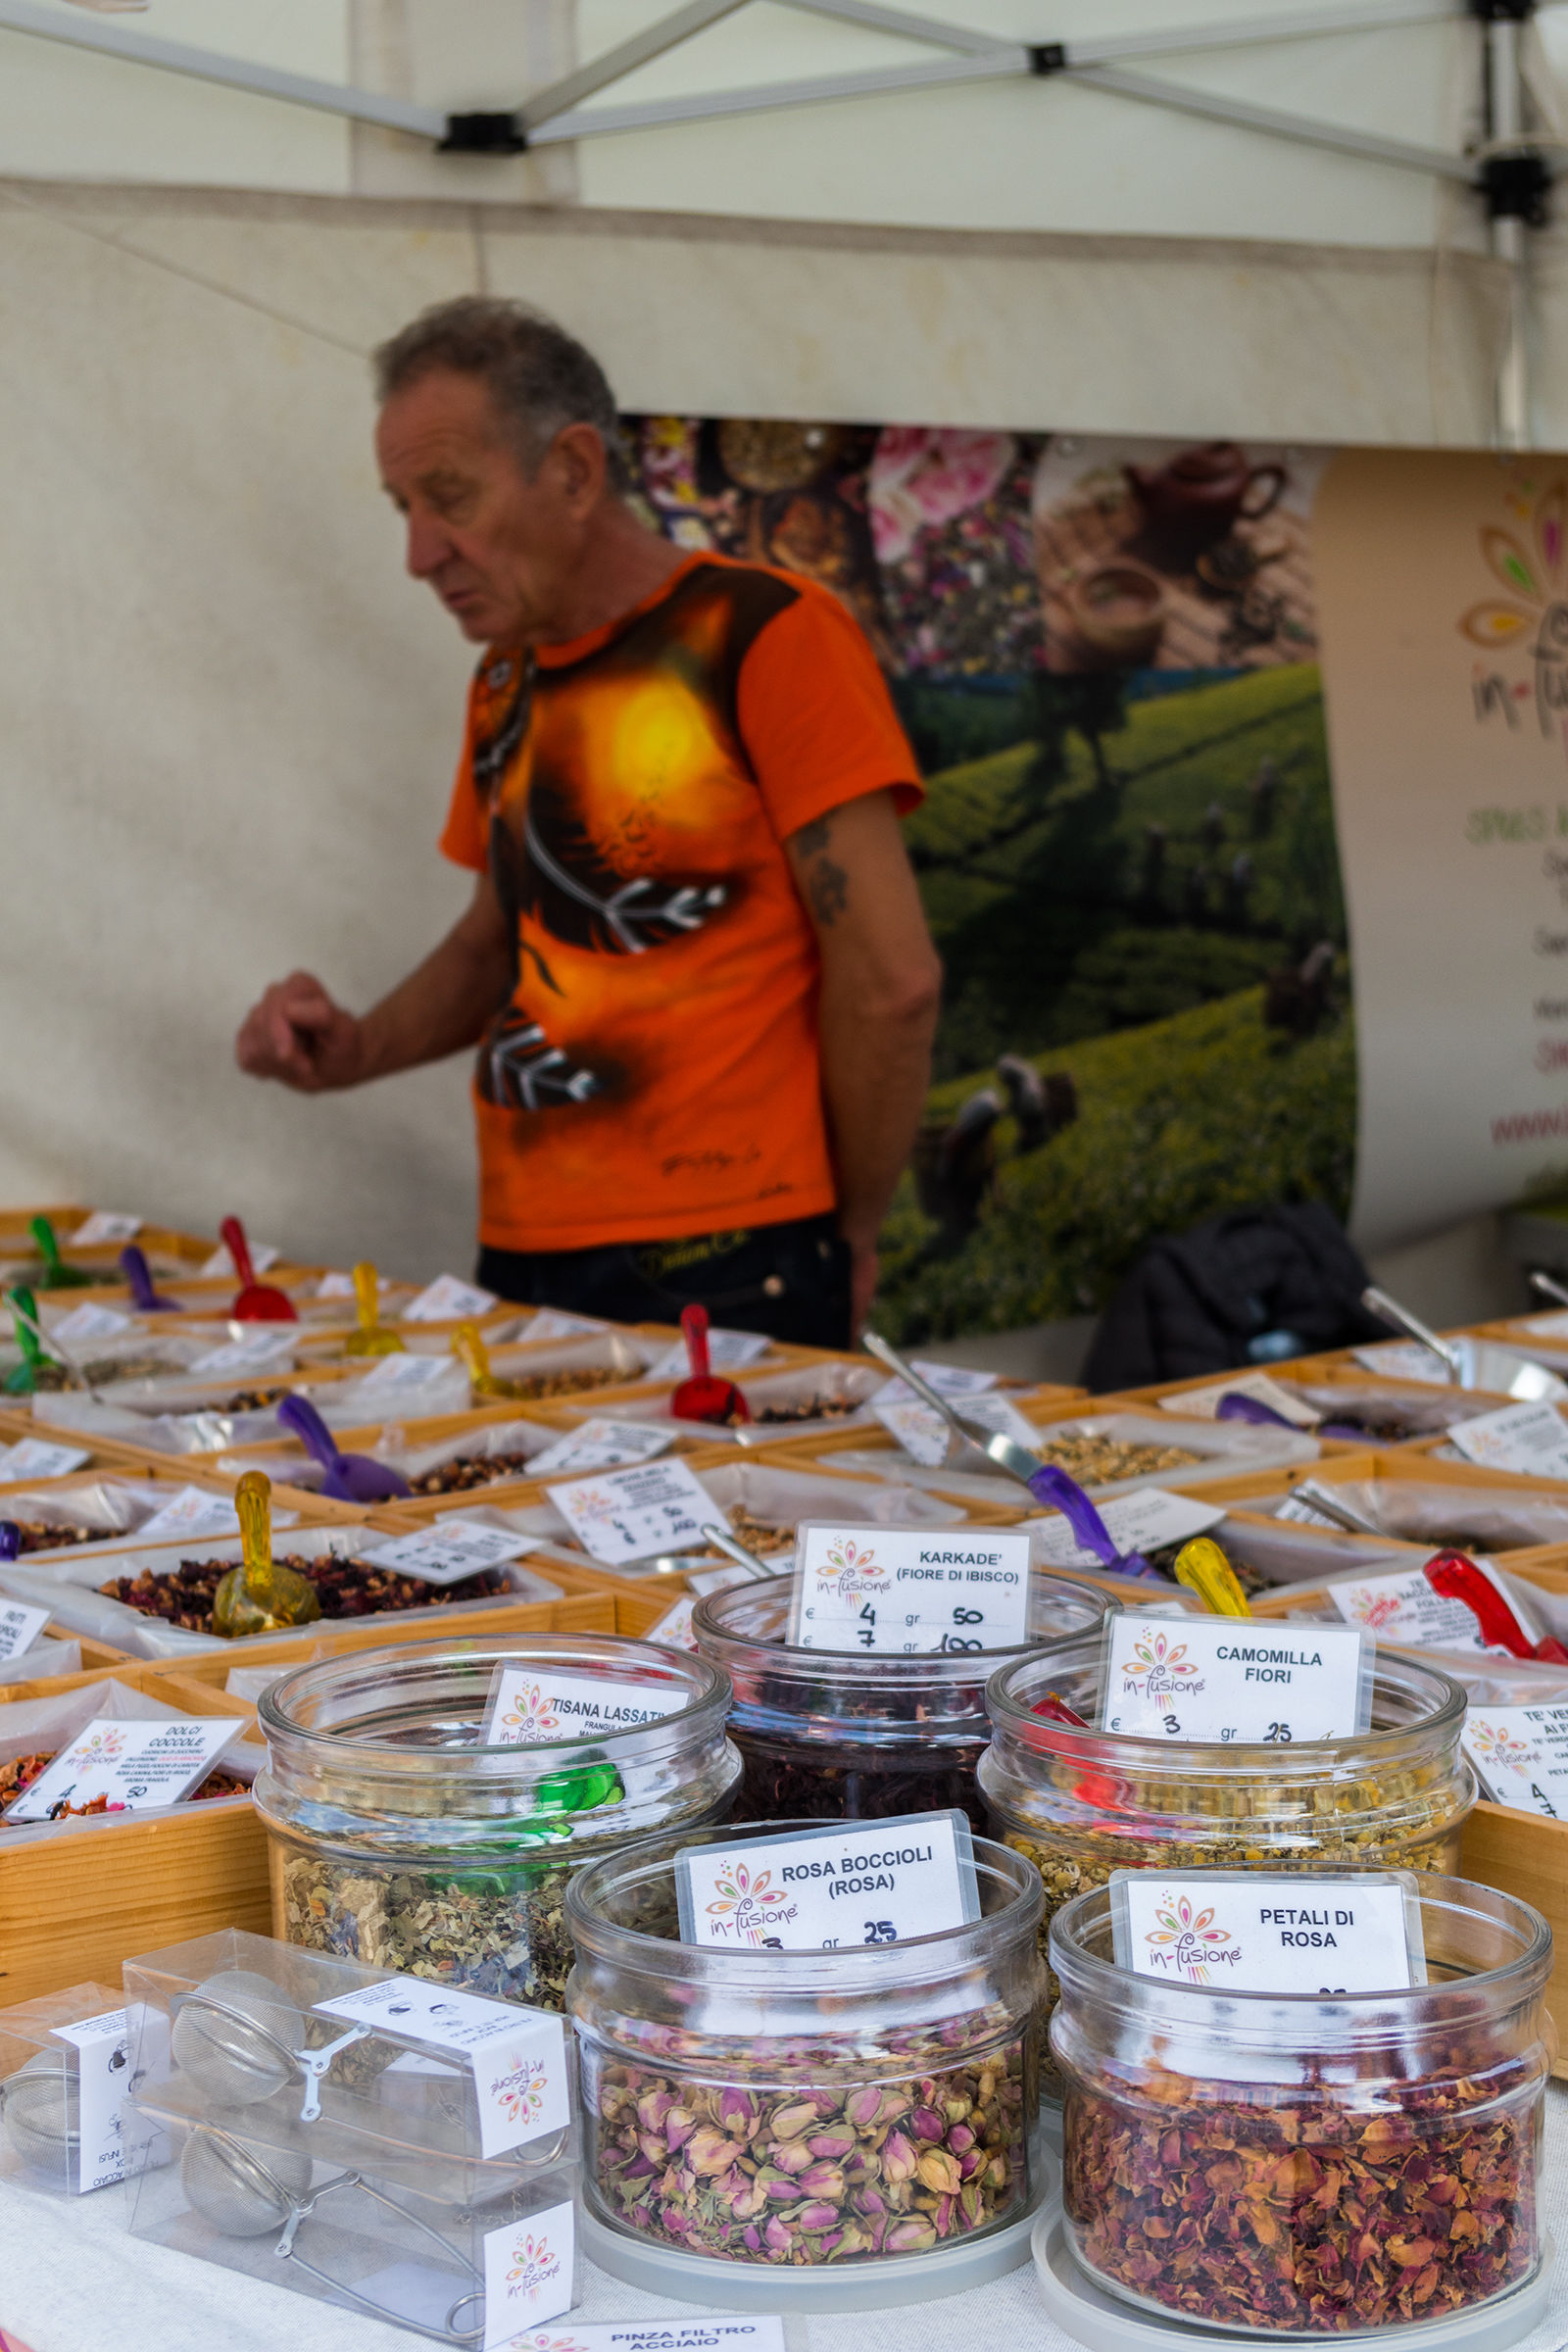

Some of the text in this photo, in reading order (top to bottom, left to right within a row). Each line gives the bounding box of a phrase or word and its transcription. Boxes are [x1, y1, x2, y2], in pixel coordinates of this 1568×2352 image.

[919, 1550, 1004, 1566] KARKADE'
[897, 1568, 1020, 1585] (FIORE DI IBISCO)
[805, 1602, 984, 1626] € 4 gr 50
[858, 1630, 876, 1647] 7
[930, 1633, 983, 1651] 100
[1216, 1645, 1323, 1666] CAMOMILLA
[1245, 1667, 1292, 1684] FIORI
[553, 1697, 601, 1718] TISANA
[1522, 1710, 1544, 1722] TE'
[166, 1725, 203, 1736] DOLCI
[1110, 1715, 1293, 1742] € 3 gr 25
[149, 1737, 207, 1747] COCCOLE
[59, 1784, 76, 1799] 4
[126, 1785, 148, 1798] 50
[1531, 1783, 1548, 1802] 4
[781, 1845, 933, 1883] ROSA BOCCIOLI
[828, 1873, 895, 1899] (ROSA)
[1260, 1908, 1354, 1926] PETALI DI
[863, 1920, 898, 1943] 25
[1281, 1932, 1338, 1947] ROSA
[98, 2149, 120, 2164] INFUSI
[93, 2171, 124, 2186] ACCIAIO
[612, 2326, 757, 2342] PINZA FILTRO
[629, 2337, 720, 2351] ACCIAIO
